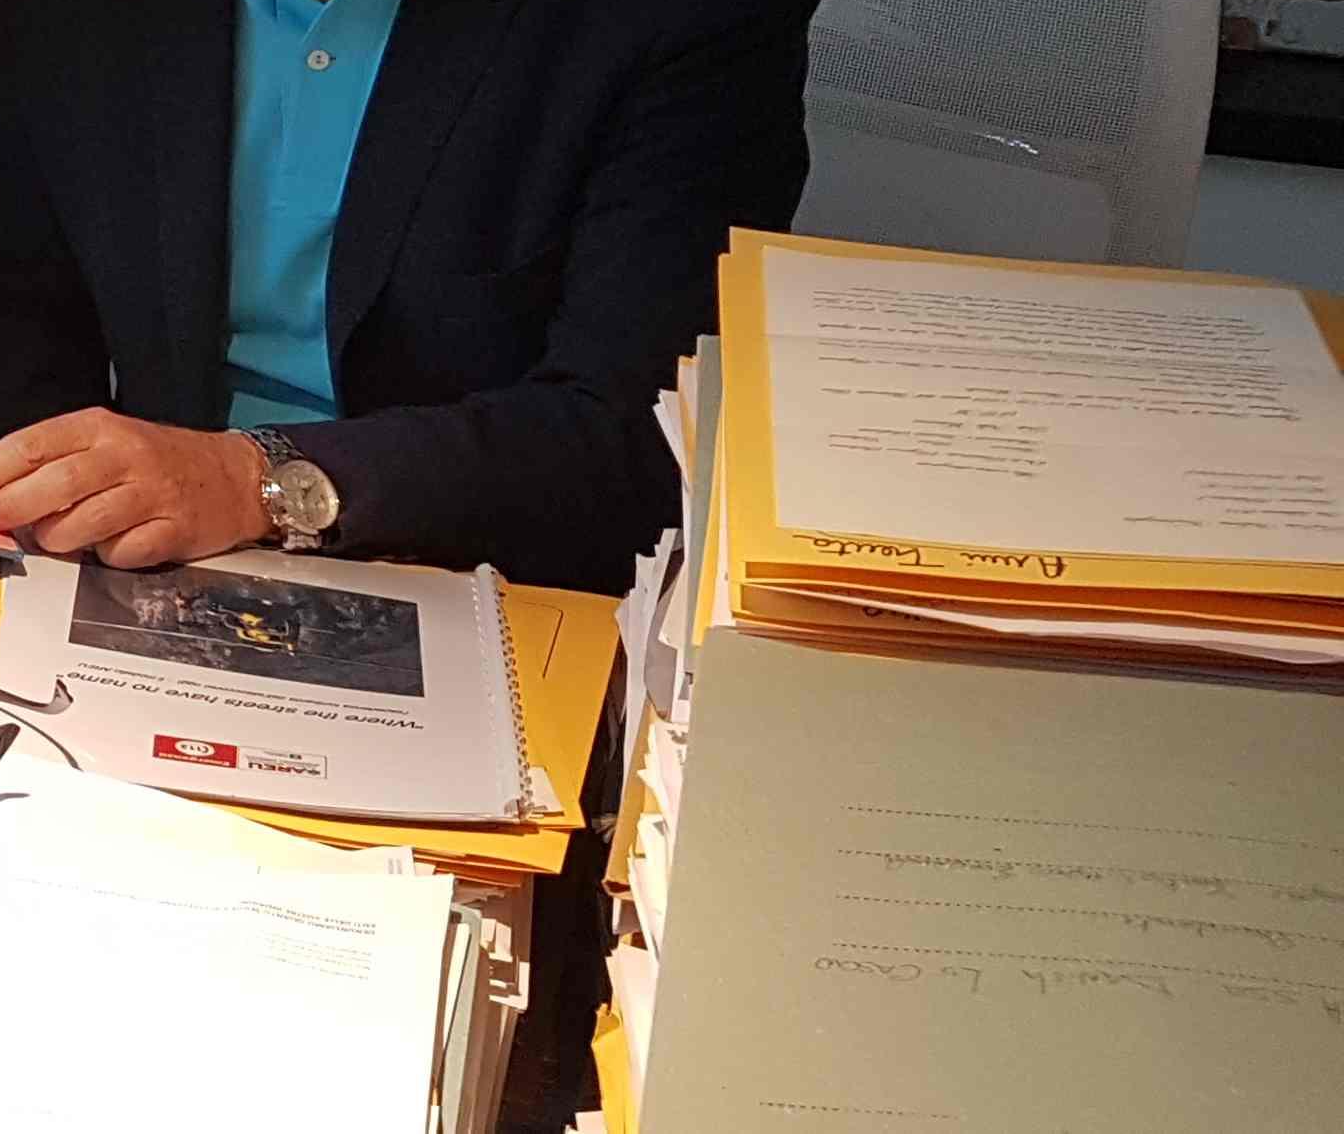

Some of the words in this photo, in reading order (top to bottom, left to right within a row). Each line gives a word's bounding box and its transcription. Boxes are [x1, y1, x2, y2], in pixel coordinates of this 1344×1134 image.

[131, 682, 159, 694] no
[165, 688, 217, 705] have
[223, 697, 299, 716] streets
[303, 708, 339, 722] the
[247, 760, 304, 775] AREU
